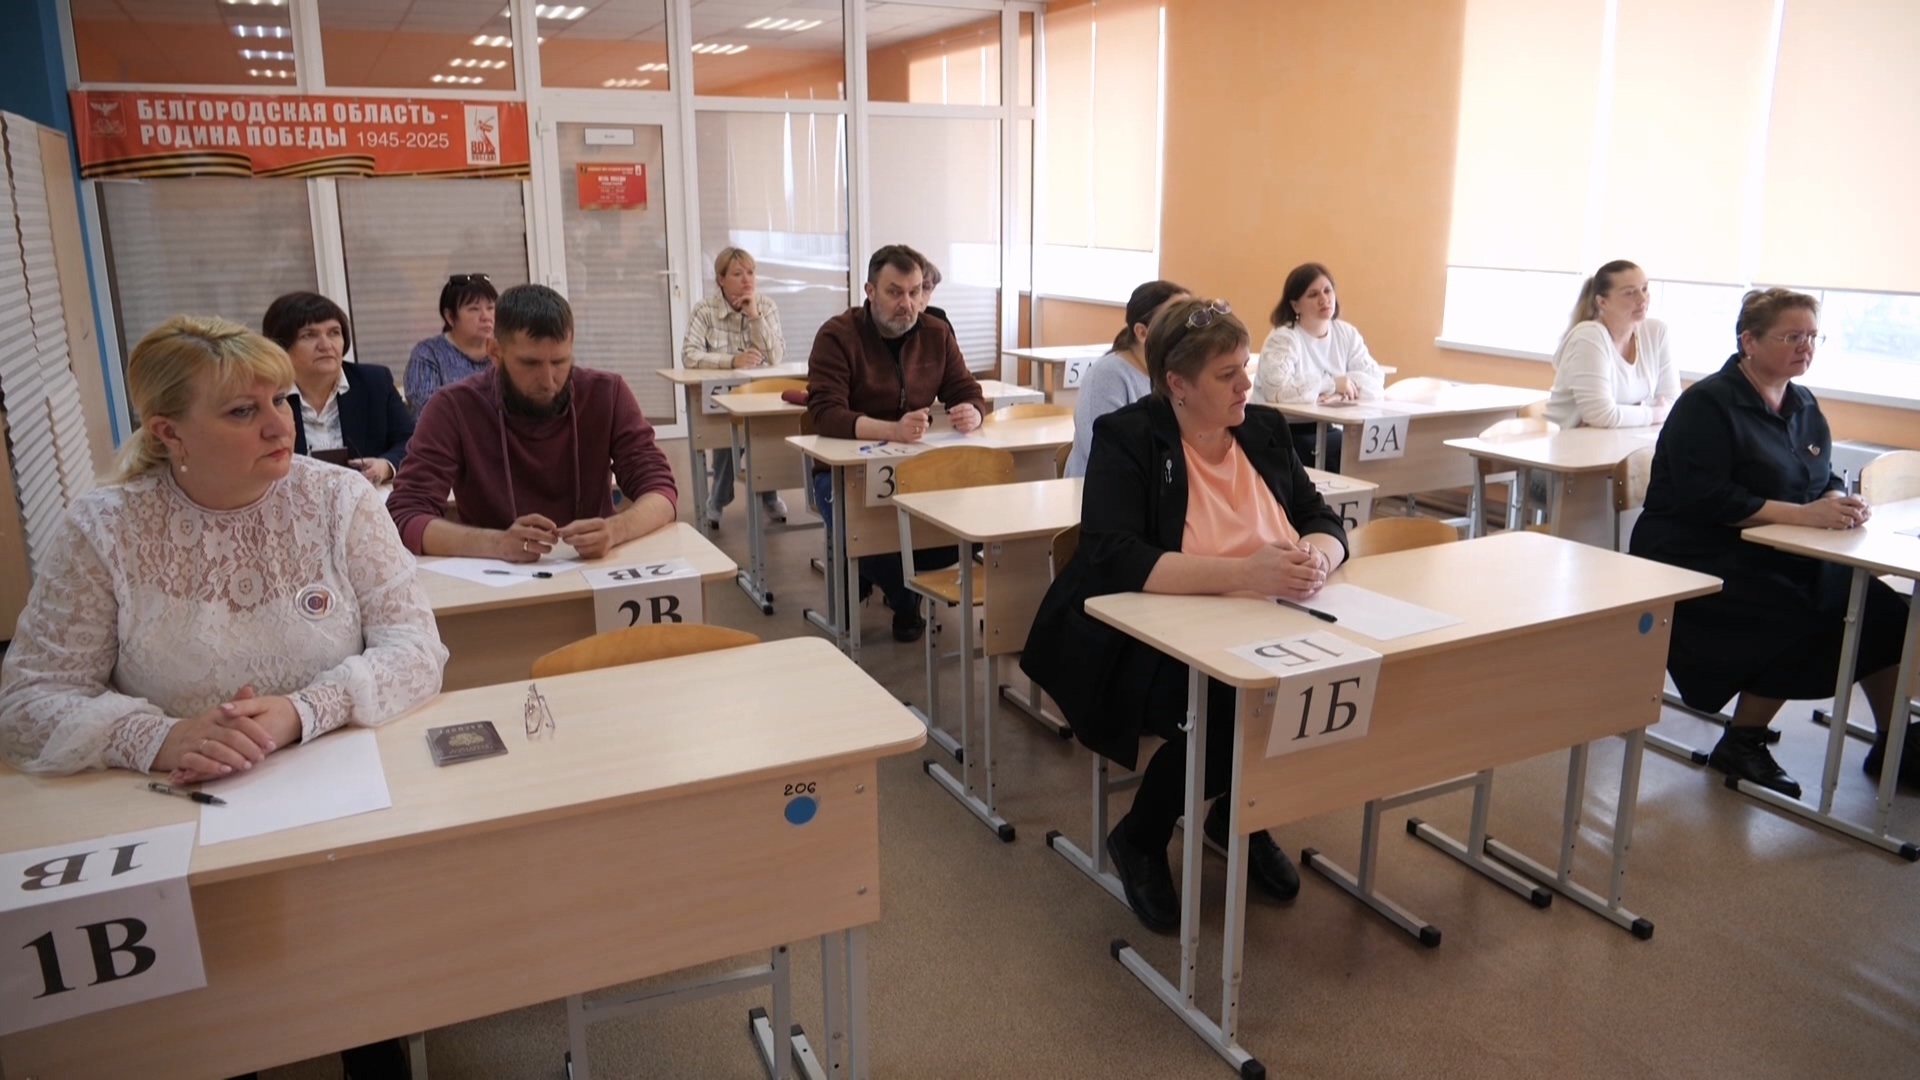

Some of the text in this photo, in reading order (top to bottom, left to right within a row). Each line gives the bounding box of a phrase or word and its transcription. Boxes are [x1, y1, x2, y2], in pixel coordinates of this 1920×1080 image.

[136, 99, 327, 124] БЕЛГОРОДСКАЯ
[333, 103, 436, 125] ОБЛАСТЬ
[140, 124, 450, 149] РОДИНА ПОБЕДЫ 1945-2025
[1365, 424, 1400, 454] 3А
[877, 465, 895, 499] 3
[1339, 501, 1359, 531] Б
[607, 564, 673, 580] 2В
[1254, 638, 1344, 667] 1Б
[1291, 676, 1361, 741] 1Б
[784, 782, 817, 796] 206
[21, 841, 149, 891] 1В
[22, 917, 156, 1000] 1В
